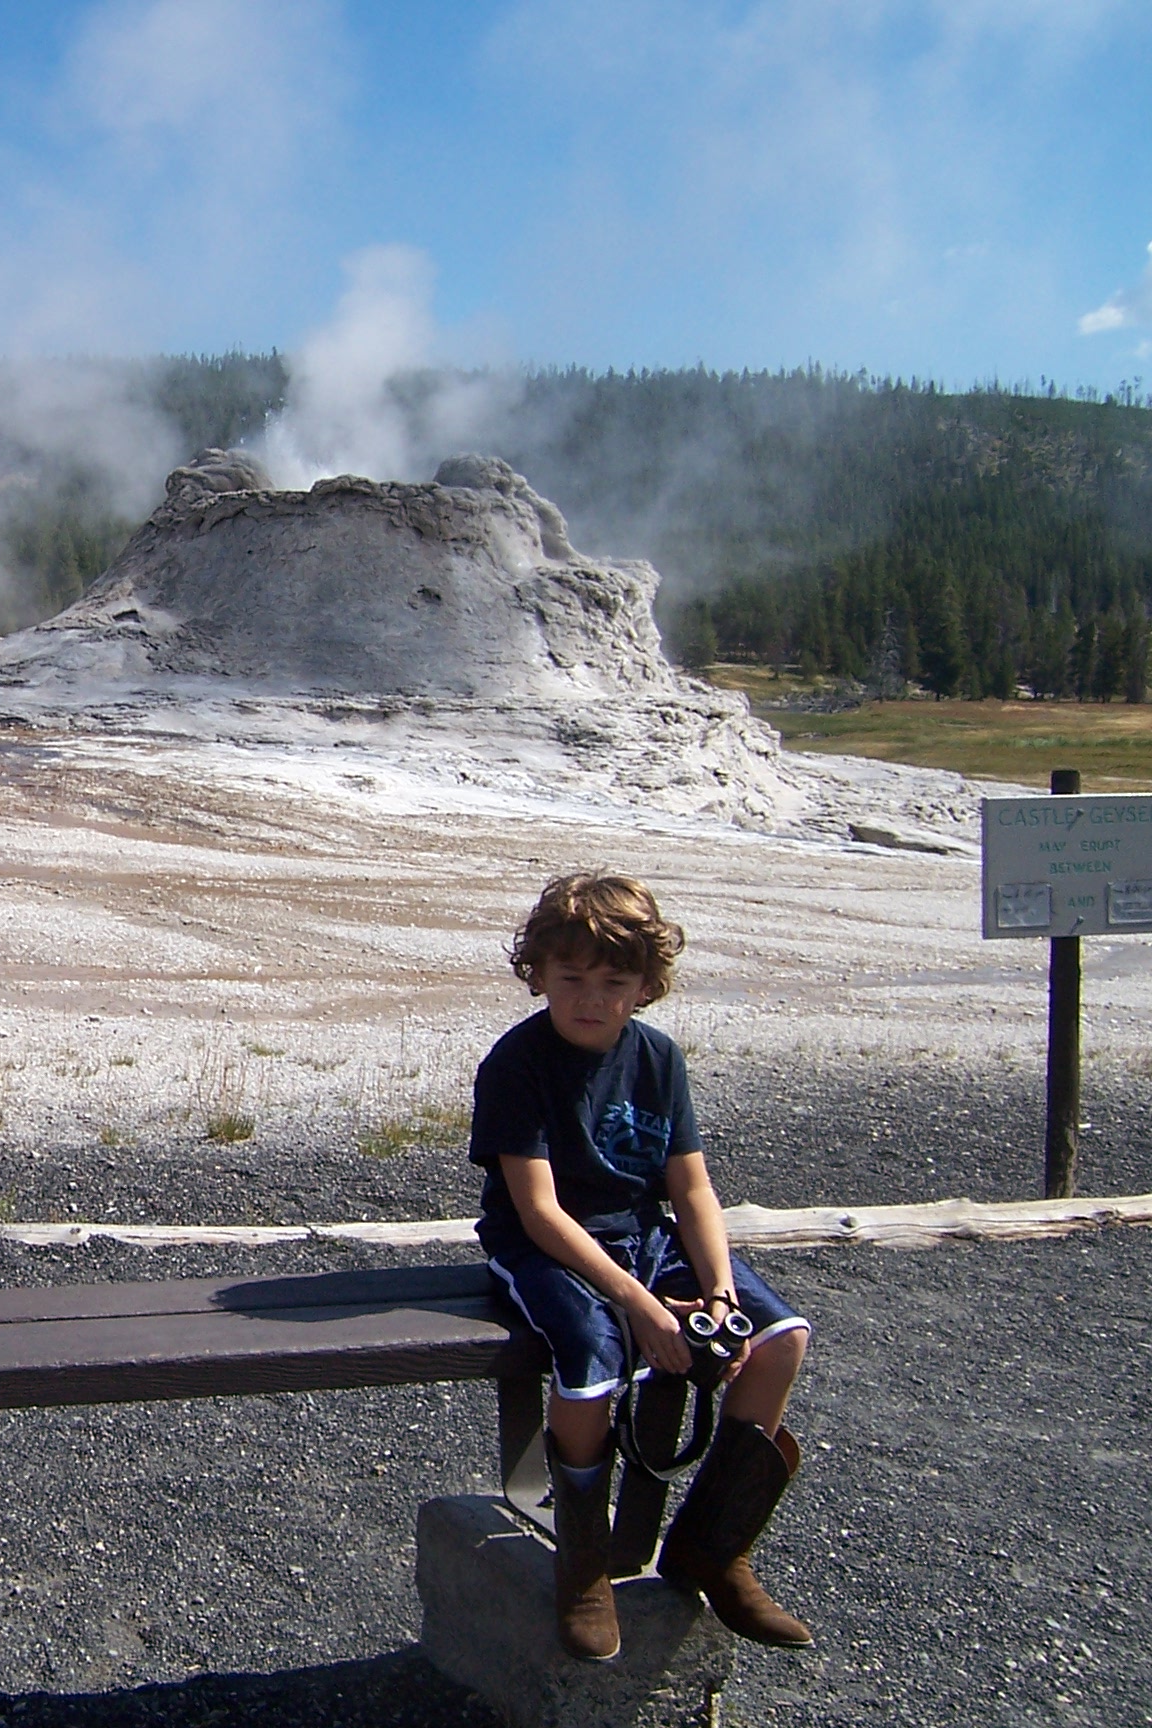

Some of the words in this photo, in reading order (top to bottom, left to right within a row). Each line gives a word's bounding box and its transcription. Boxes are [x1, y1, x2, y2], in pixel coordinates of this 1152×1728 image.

[998, 806, 1077, 826] CASTLE
[1089, 805, 1152, 825] GEYSE
[1038, 841, 1067, 853] MAY
[1079, 838, 1121, 852] ERUPT
[1049, 860, 1112, 875] BETWEEN
[1067, 895, 1095, 908] AND
